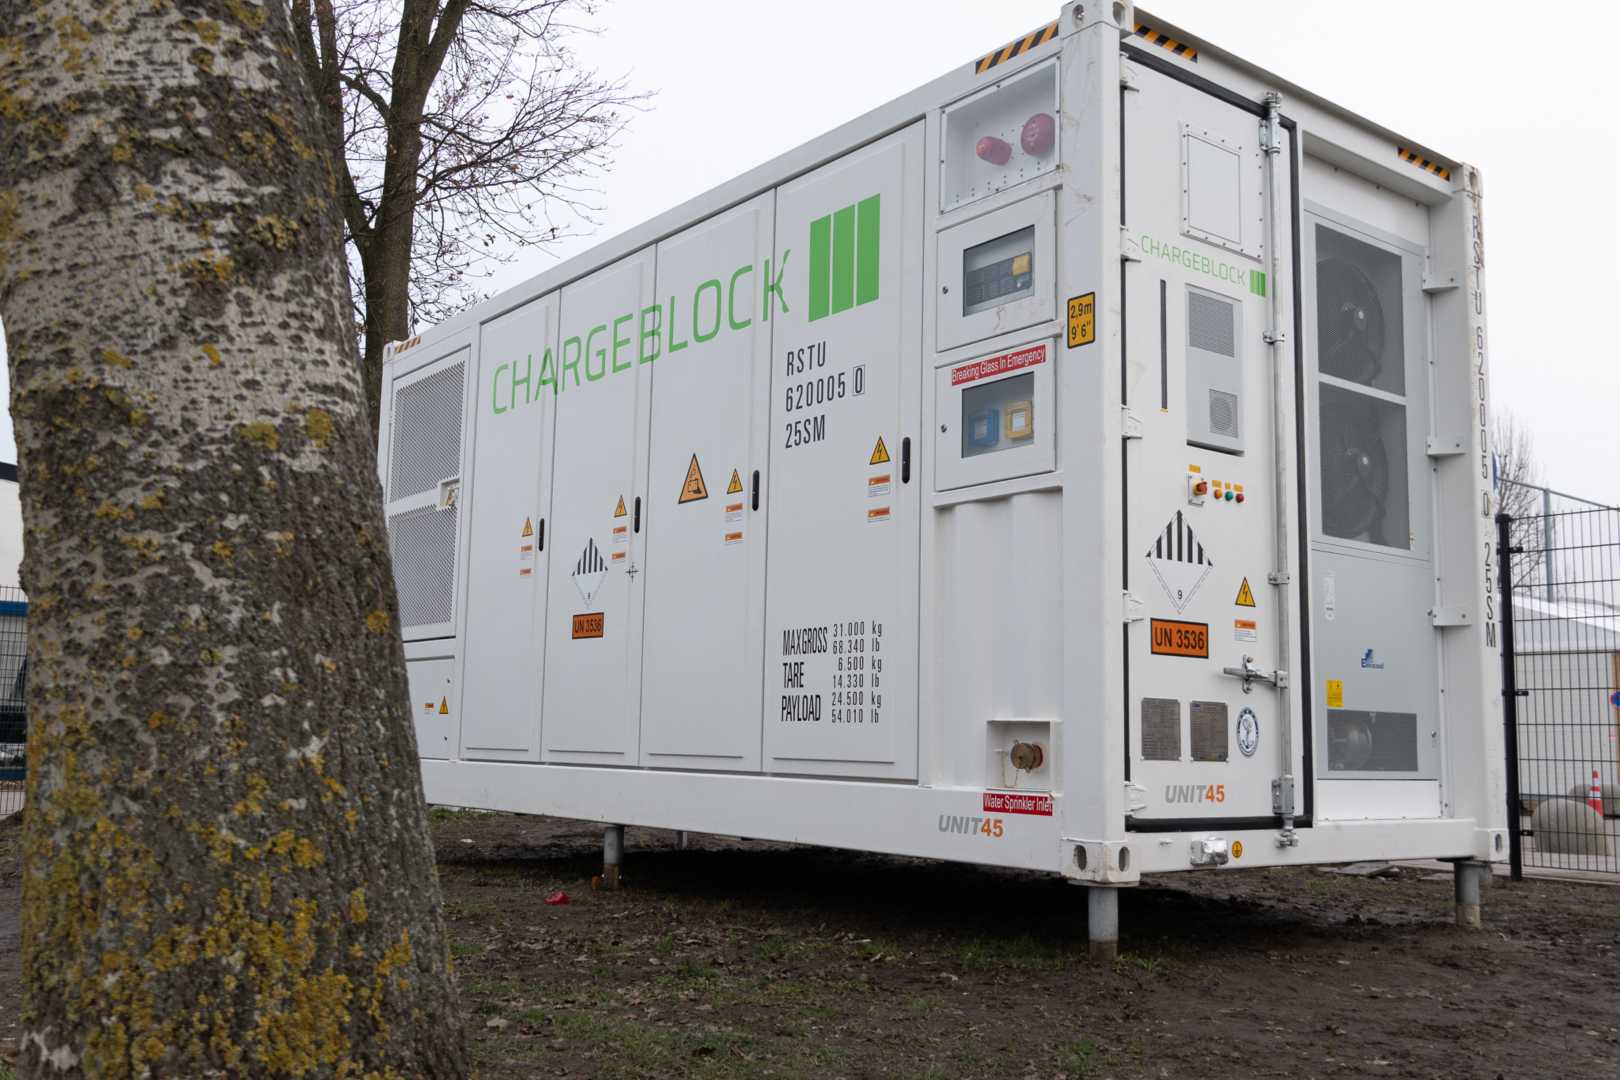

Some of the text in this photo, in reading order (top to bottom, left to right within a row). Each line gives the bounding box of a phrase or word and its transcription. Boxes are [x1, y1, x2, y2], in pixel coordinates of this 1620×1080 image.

[1141, 235, 1246, 286] CHARGEBLOCK
[492, 249, 791, 414] CHARGEBLOCK
[787, 341, 826, 376] RSTU
[952, 349, 1045, 383] Breaking Glass In Emergency
[786, 366, 864, 412] 620005 0
[1476, 326, 1488, 479] 620005
[785, 414, 825, 448] 25SM
[1482, 492, 1489, 517] 0
[1177, 590, 1183, 600] 9
[1484, 542, 1496, 648] 25SM
[783, 620, 882, 656] MAXGROSS 31.000 kg
[832, 638, 880, 654] 68.340 lb
[1154, 627, 1205, 650] UN 3536
[783, 662, 880, 688] TARE 14.330 lb
[838, 656, 882, 672] 6.500 kg
[781, 694, 821, 722] PAYLOAD
[832, 708, 863, 724] 54.010
[832, 690, 882, 708] 24.500 kg
[984, 793, 1052, 813] Water Sprinkler Inlet
[1165, 784, 1225, 803] UNIT45
[938, 814, 1004, 838] UNIT45
